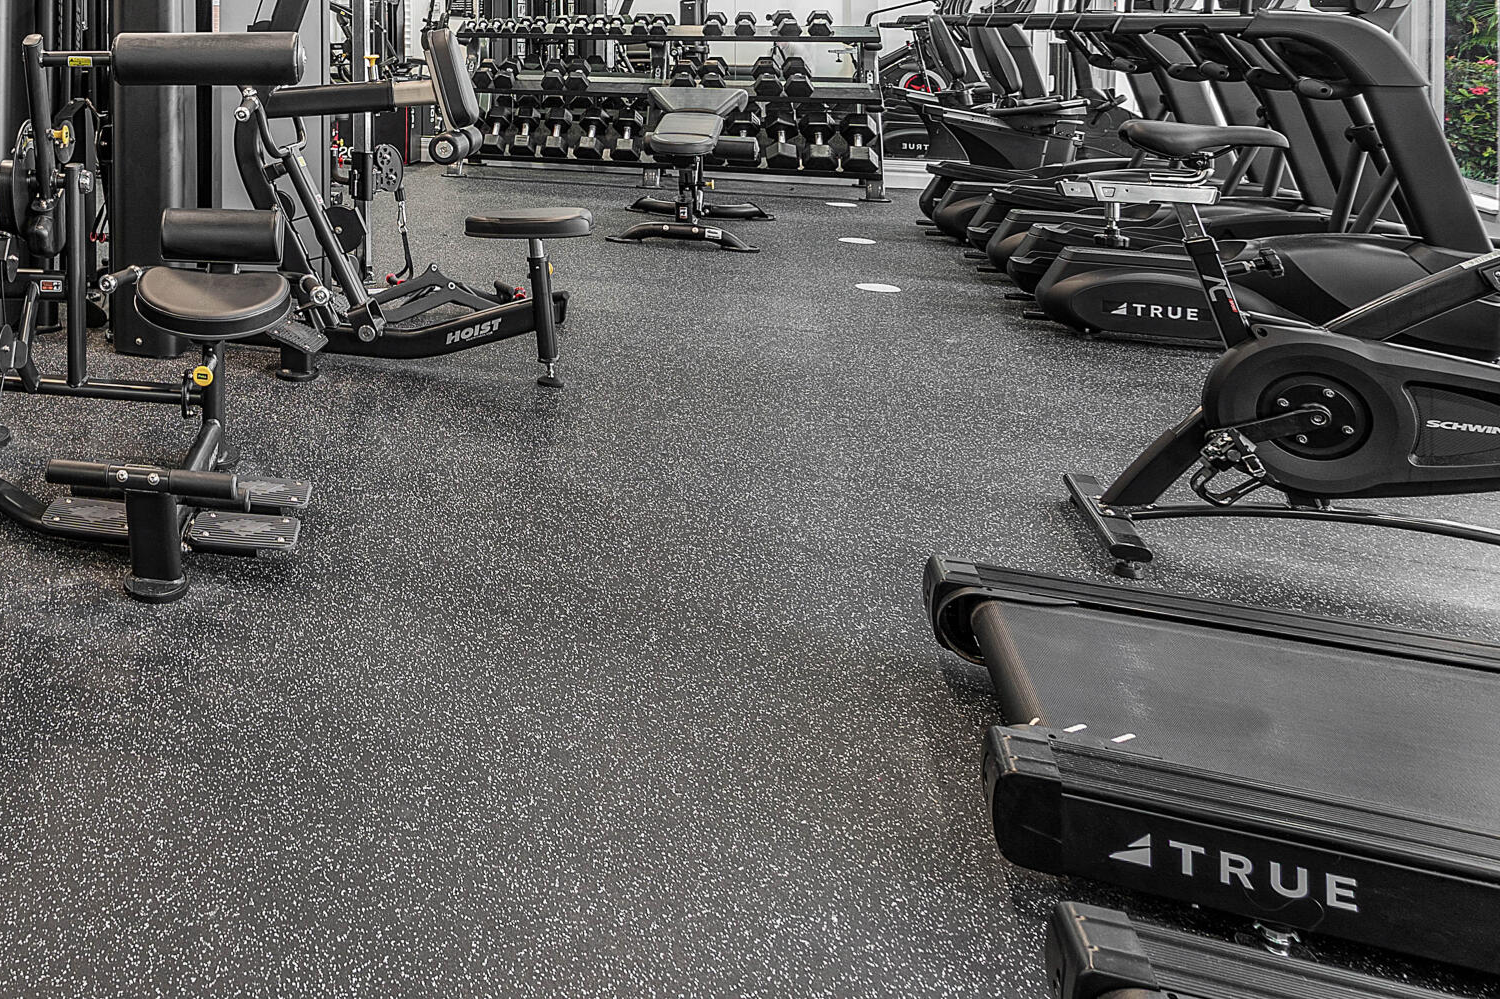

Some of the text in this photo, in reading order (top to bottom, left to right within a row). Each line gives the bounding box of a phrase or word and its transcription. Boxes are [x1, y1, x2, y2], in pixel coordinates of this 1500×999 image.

[1132, 303, 1199, 321] TRUE
[446, 317, 502, 345] HOIST
[1168, 839, 1359, 913] TRUE
